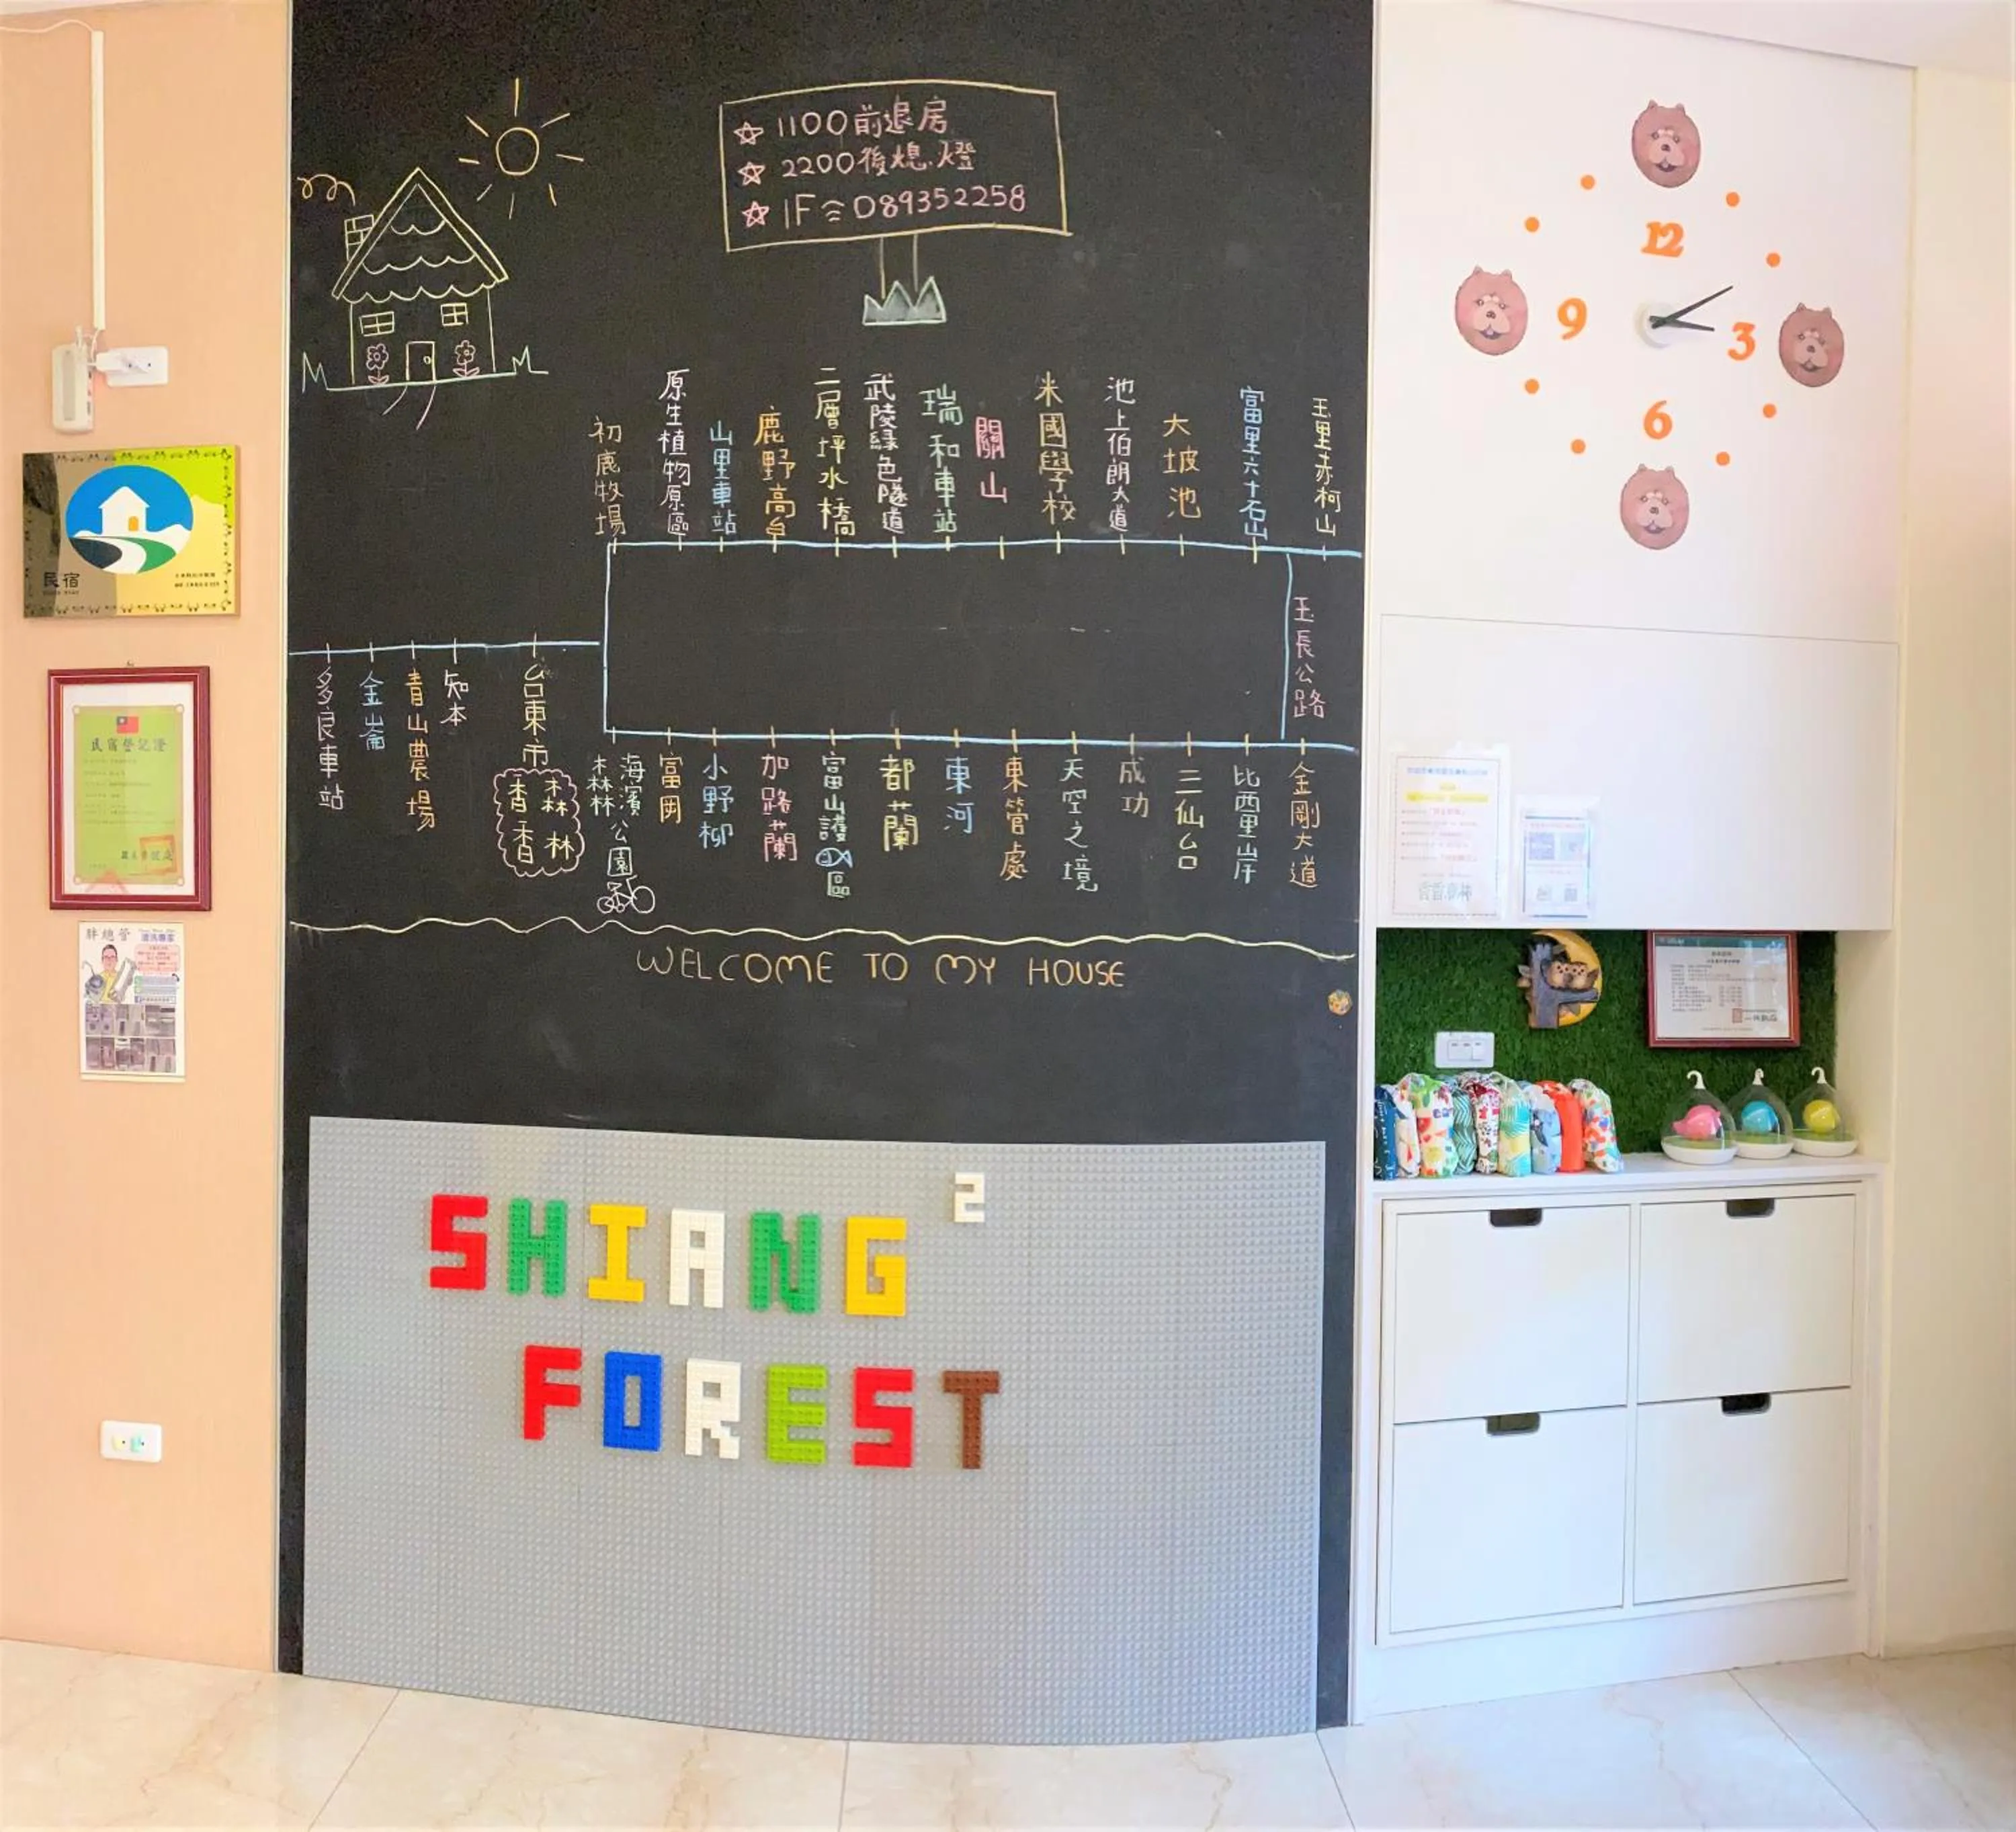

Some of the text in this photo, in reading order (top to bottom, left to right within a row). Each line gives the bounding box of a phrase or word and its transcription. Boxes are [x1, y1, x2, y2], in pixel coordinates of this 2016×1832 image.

[854, 184, 1025, 218] 089352258
[1641, 222, 1685, 257] 12
[1556, 298, 1588, 340] 9
[1728, 321, 1756, 361] 3
[753, 405, 796, 536] 鹿野高台
[814, 368, 855, 536] 二層坪水橋
[919, 384, 964, 532] 瑞和車站
[1035, 372, 1075, 524] 米國學校
[1105, 377, 1135, 532] 池上伯朗大道
[1163, 413, 1201, 517] 大坡池
[1240, 385, 1267, 539] 富里六十石山
[1643, 400, 1673, 440] 6
[710, 421, 736, 534] 山里車站
[43, 572, 80, 589] 民宿
[316, 667, 344, 810] 多良車站
[405, 668, 435, 831] 青山農場
[441, 670, 468, 726] 知本
[522, 663, 549, 767] 台東市
[699, 753, 734, 848] 小野柳
[761, 753, 798, 863] 加路蘭
[880, 755, 918, 851] 都蘭
[945, 757, 974, 833] 東河
[1060, 759, 1098, 892] 天空之境
[1120, 757, 1148, 817] 成功
[1175, 770, 1204, 869] 三仙台
[1288, 763, 1320, 888] 金剛大道
[637, 947, 1124, 987] WELCOME TO MY HOUSE
[430, 1172, 986, 1316] SHIANG 2
[523, 1345, 1000, 1469] FOREST
